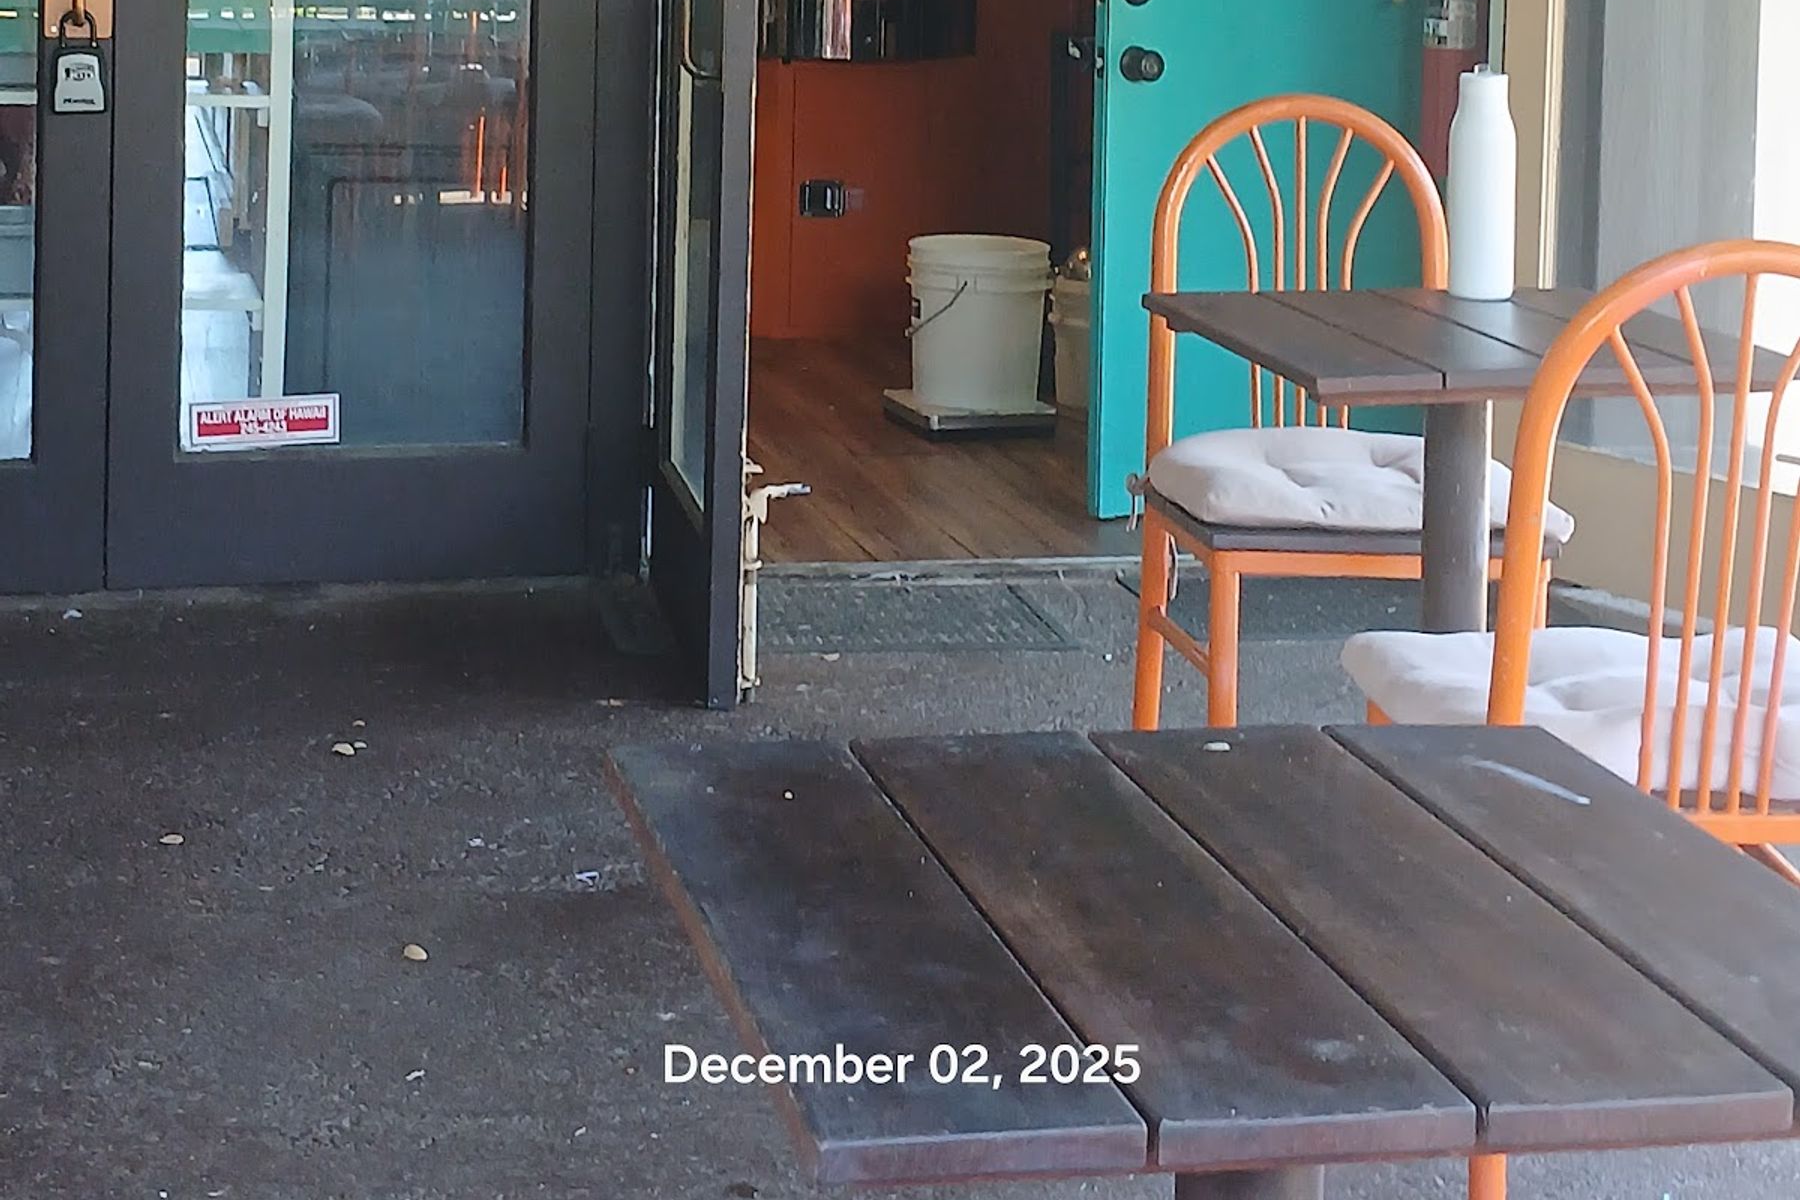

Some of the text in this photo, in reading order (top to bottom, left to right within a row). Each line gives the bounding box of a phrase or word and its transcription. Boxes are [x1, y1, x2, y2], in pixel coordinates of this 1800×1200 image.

[200, 405, 326, 424] ALERT ALARM OF HAWAII
